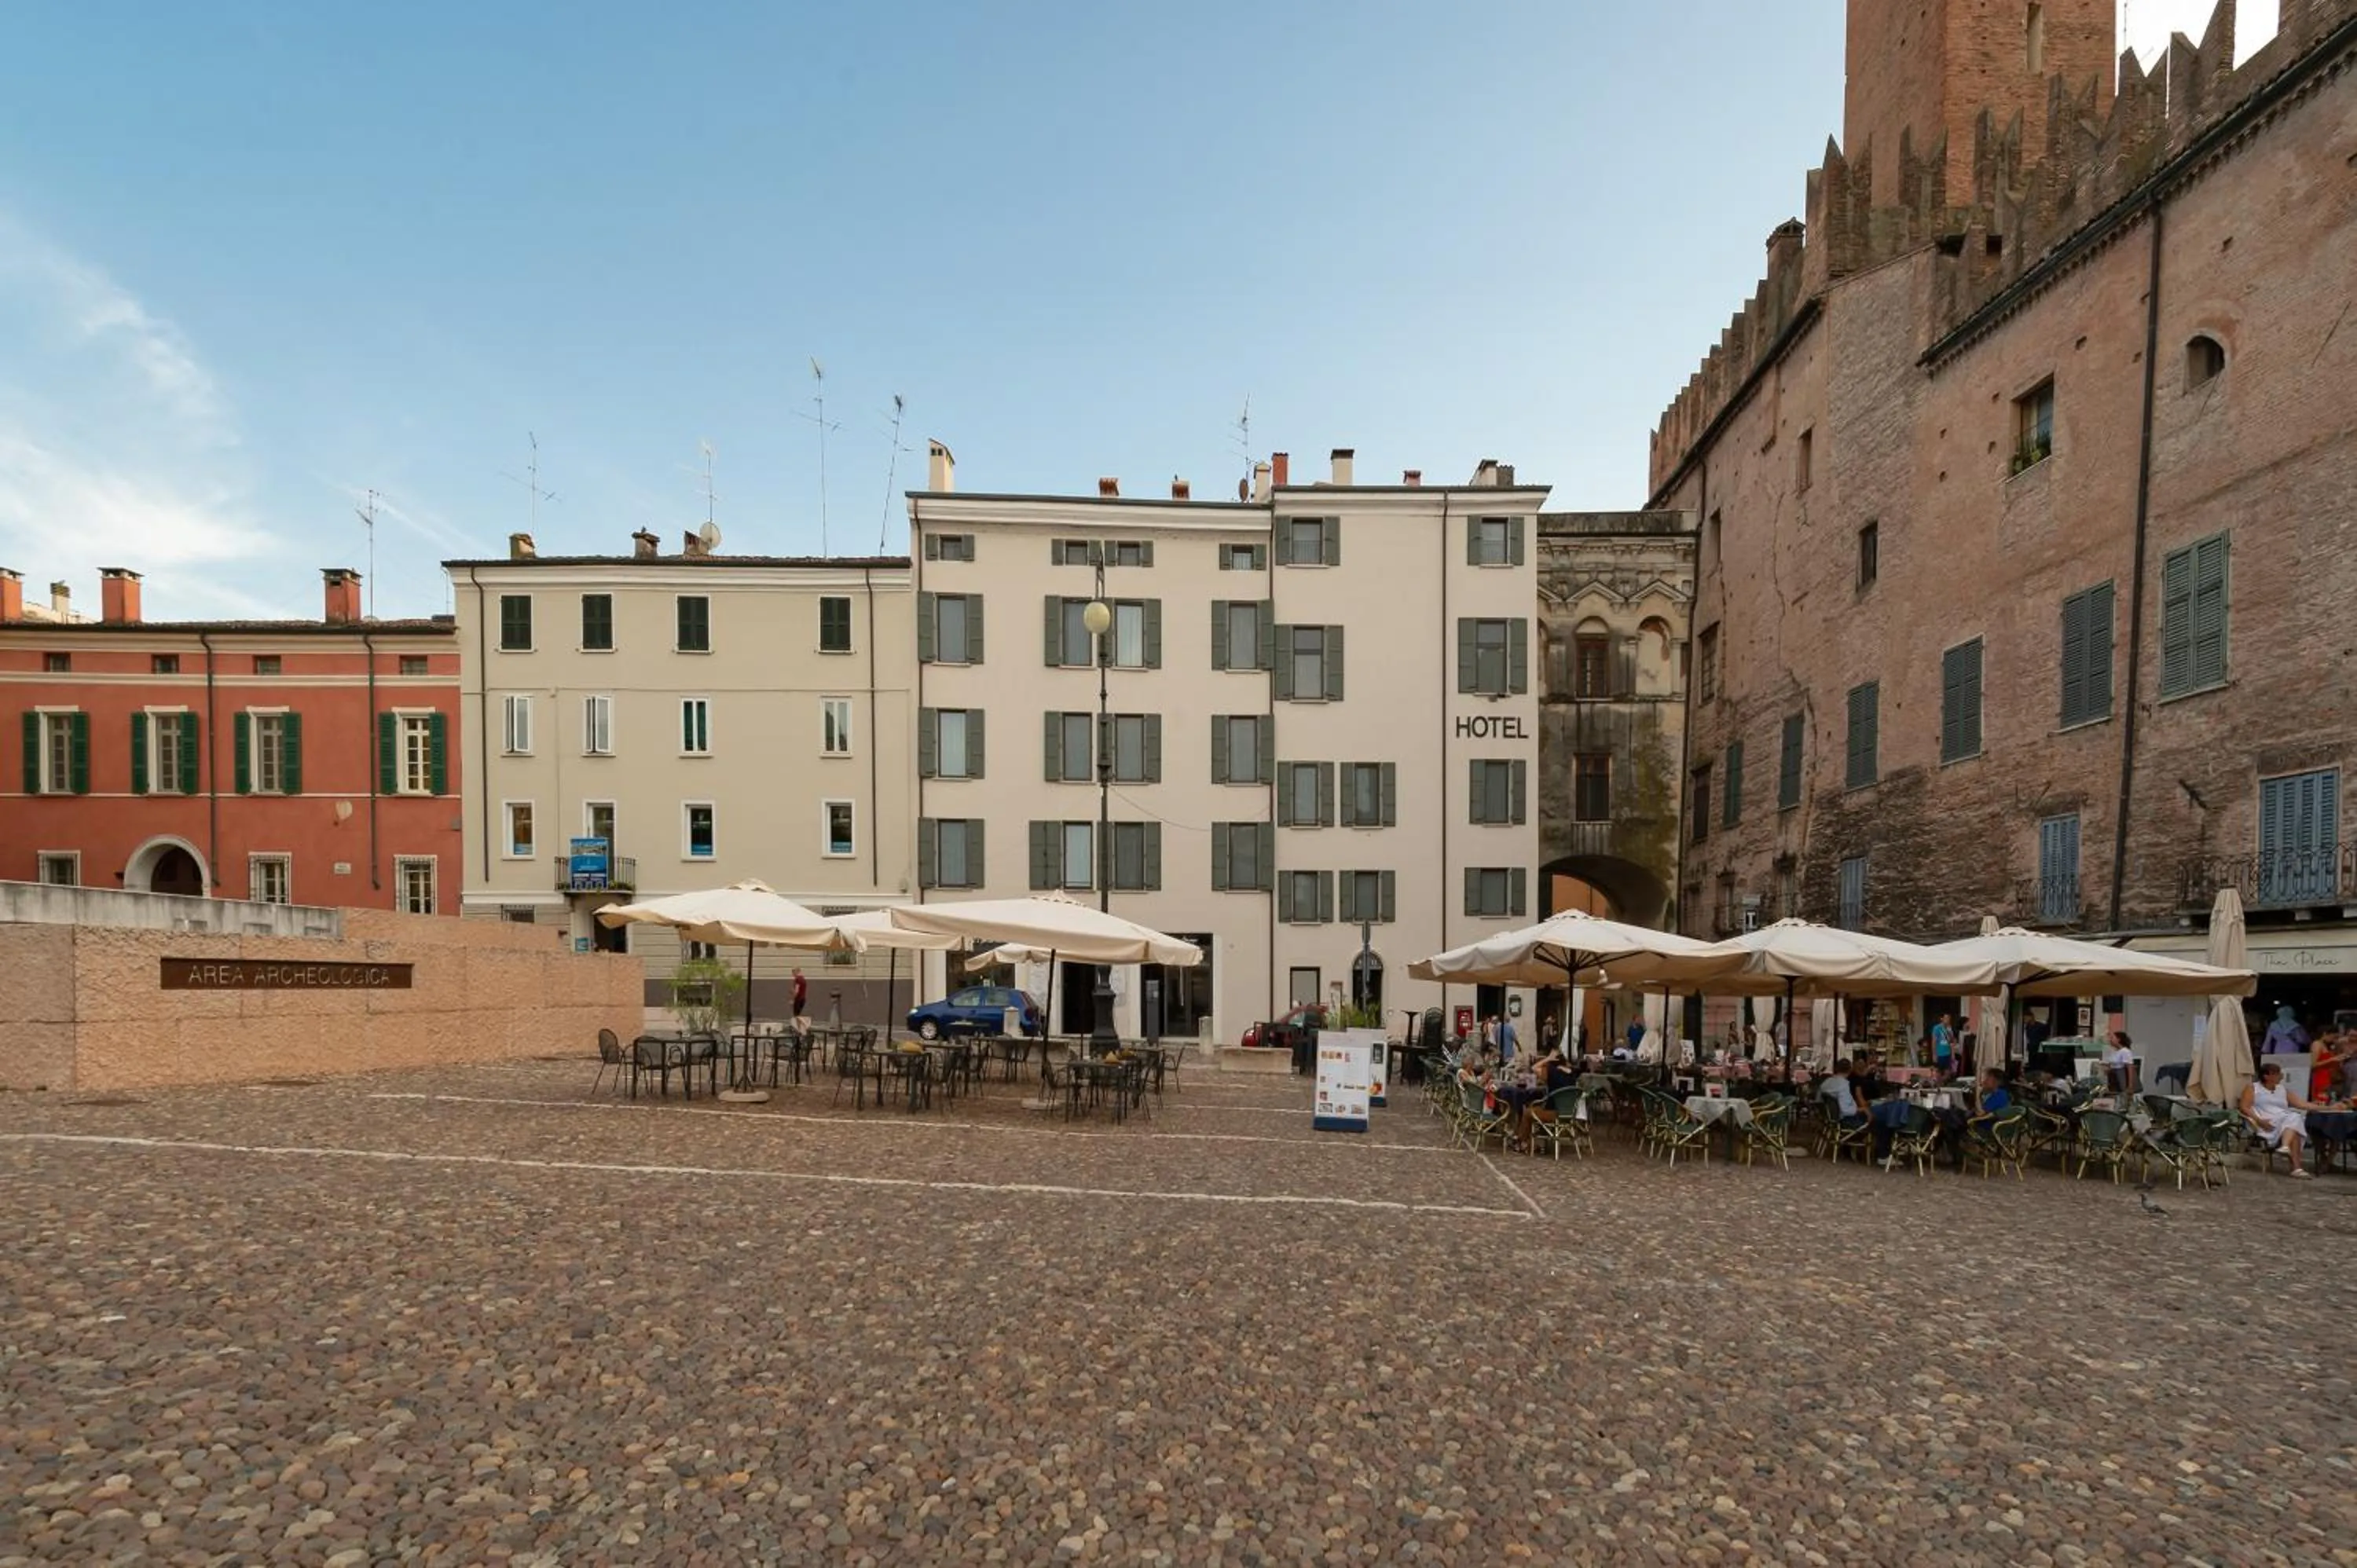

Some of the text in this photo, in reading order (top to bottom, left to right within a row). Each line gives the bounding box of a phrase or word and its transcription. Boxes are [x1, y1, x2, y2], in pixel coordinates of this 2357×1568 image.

[1456, 716, 1528, 738] HOTEL
[189, 965, 390, 985] AREA ARCHEOLOGICA
